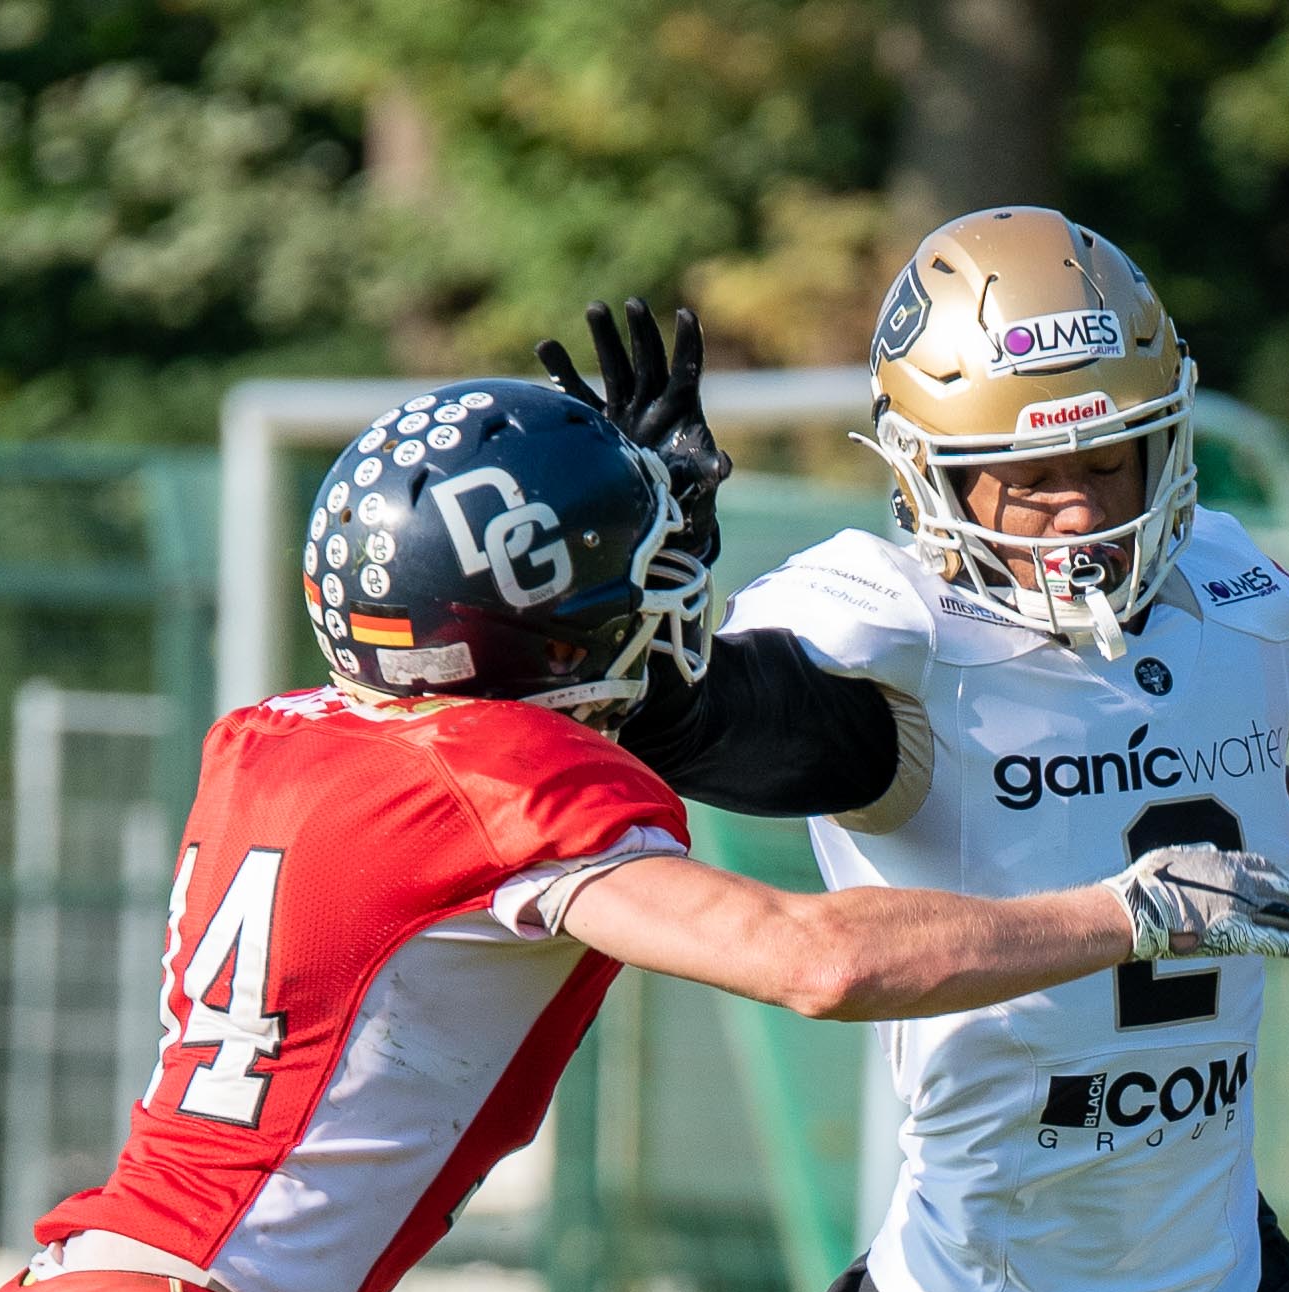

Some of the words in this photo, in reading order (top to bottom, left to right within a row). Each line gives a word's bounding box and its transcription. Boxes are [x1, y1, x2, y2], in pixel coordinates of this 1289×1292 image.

[991, 314, 1118, 363] JOLMES
[1028, 399, 1108, 429] Riddell
[429, 466, 574, 608] DG
[1200, 566, 1274, 603] JOLMES
[1083, 1074, 1107, 1128] BLACK
[1105, 1051, 1248, 1128] COM
[1037, 1109, 1235, 1152] GROUP
